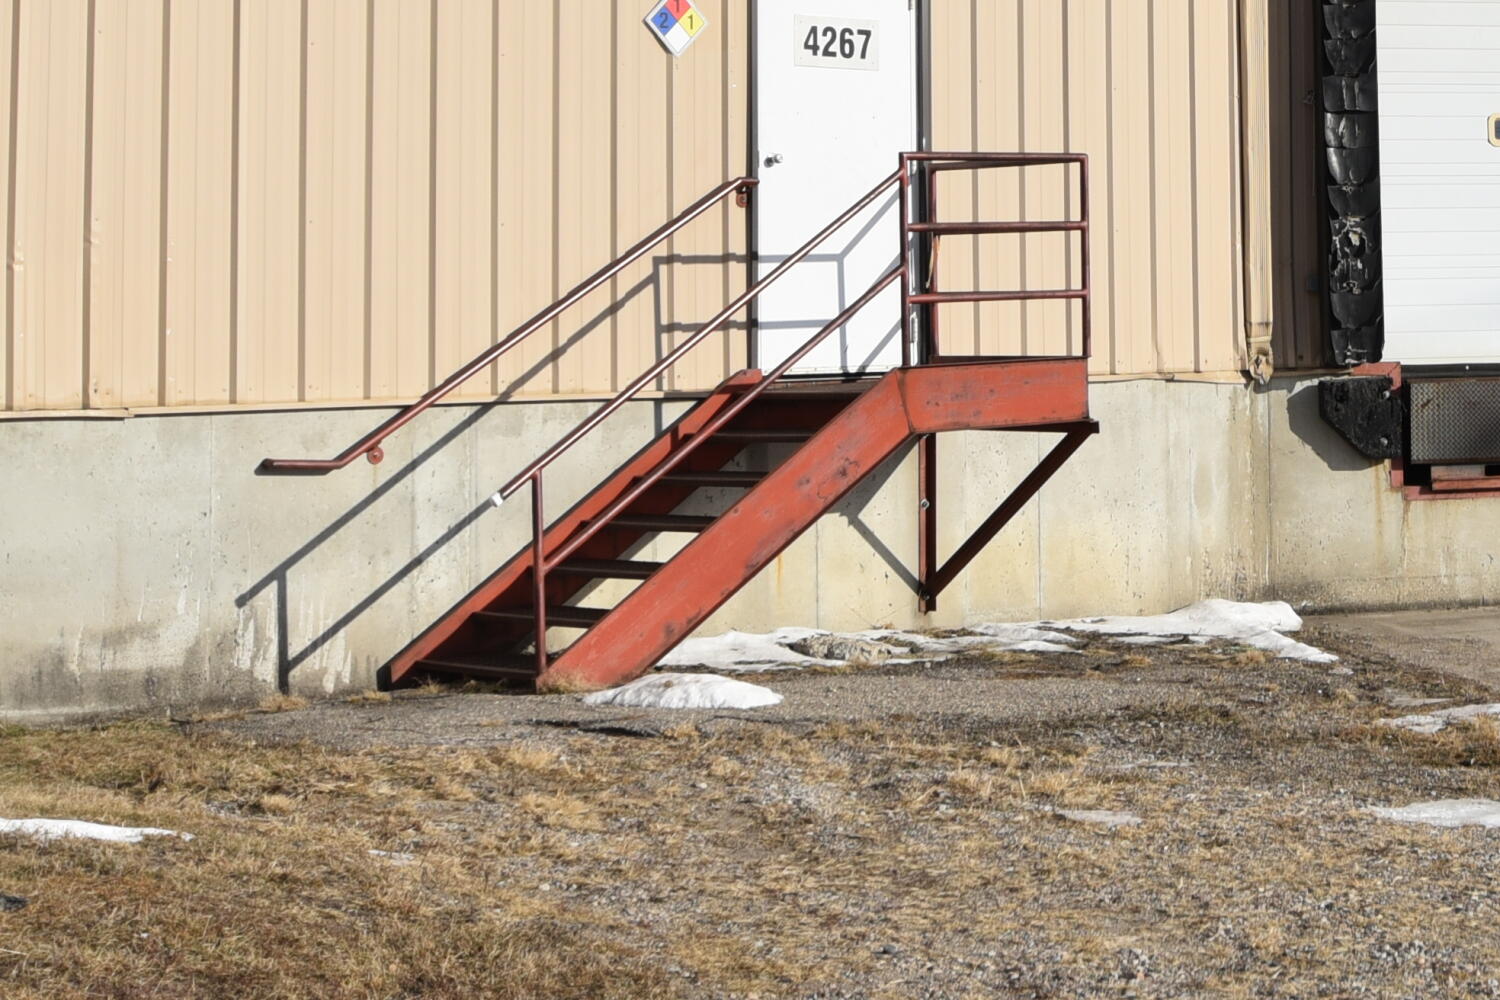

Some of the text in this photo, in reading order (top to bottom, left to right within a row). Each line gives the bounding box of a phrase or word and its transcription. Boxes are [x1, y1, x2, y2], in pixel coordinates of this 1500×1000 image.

[660, 12, 669, 28] 2
[687, 14, 693, 30] 1
[803, 25, 872, 60] 4267
